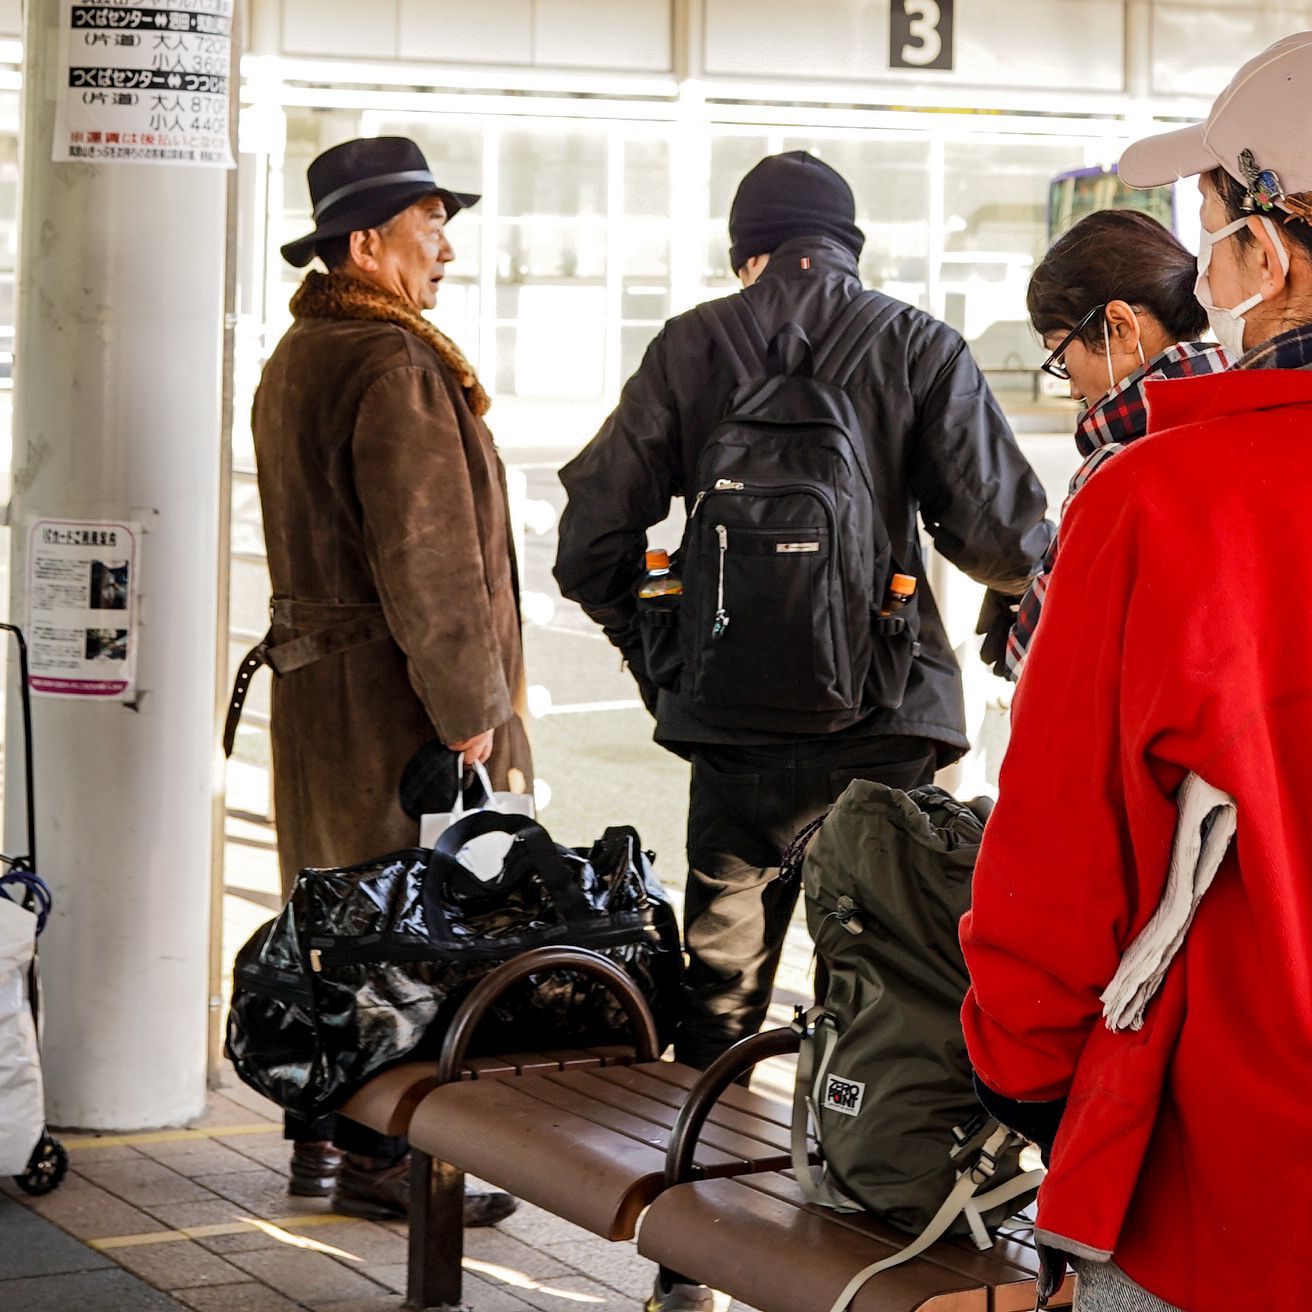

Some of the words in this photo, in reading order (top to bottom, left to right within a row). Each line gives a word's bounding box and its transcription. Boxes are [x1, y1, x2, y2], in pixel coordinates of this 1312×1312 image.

[153, 34, 189, 51] 大人
[152, 53, 188, 73] 小人
[73, 69, 165, 89] つくばセンター
[150, 96, 185, 111] 大人
[150, 115, 184, 132] 小人
